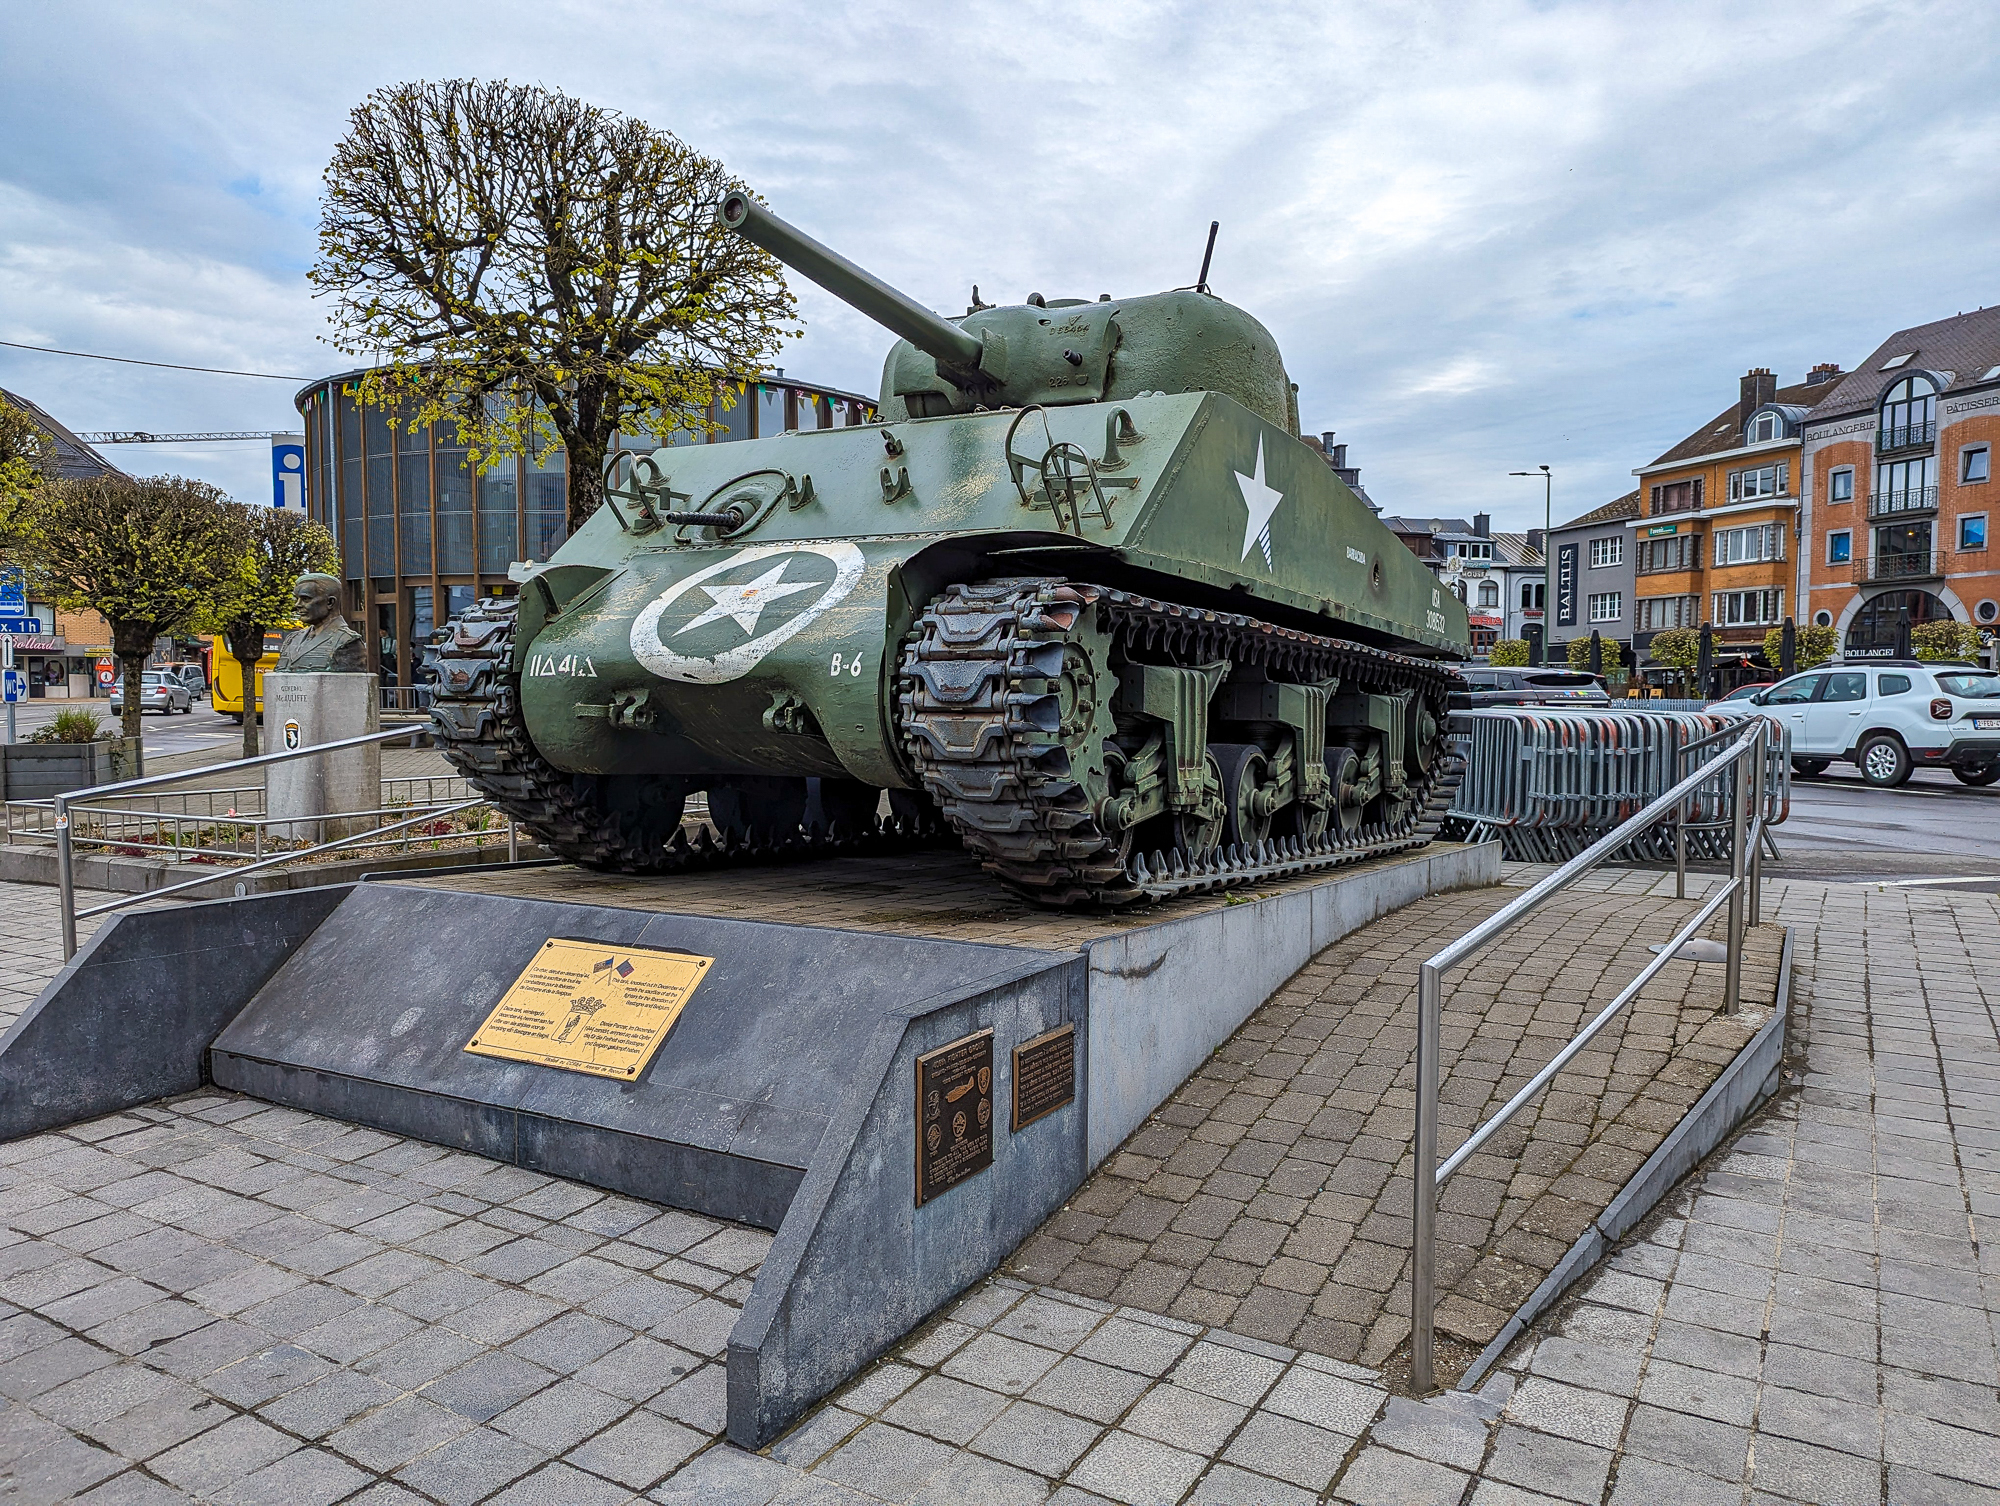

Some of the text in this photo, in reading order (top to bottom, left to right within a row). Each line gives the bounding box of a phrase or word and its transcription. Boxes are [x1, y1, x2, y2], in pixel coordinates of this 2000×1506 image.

[1806, 420, 1876, 441] BOULANGERIE
[1431, 588, 1441, 609] USA
[830, 652, 863, 677] B-6
[6, 679, 17, 694] WC
[947, 1048, 967, 1062] FIGHTER
